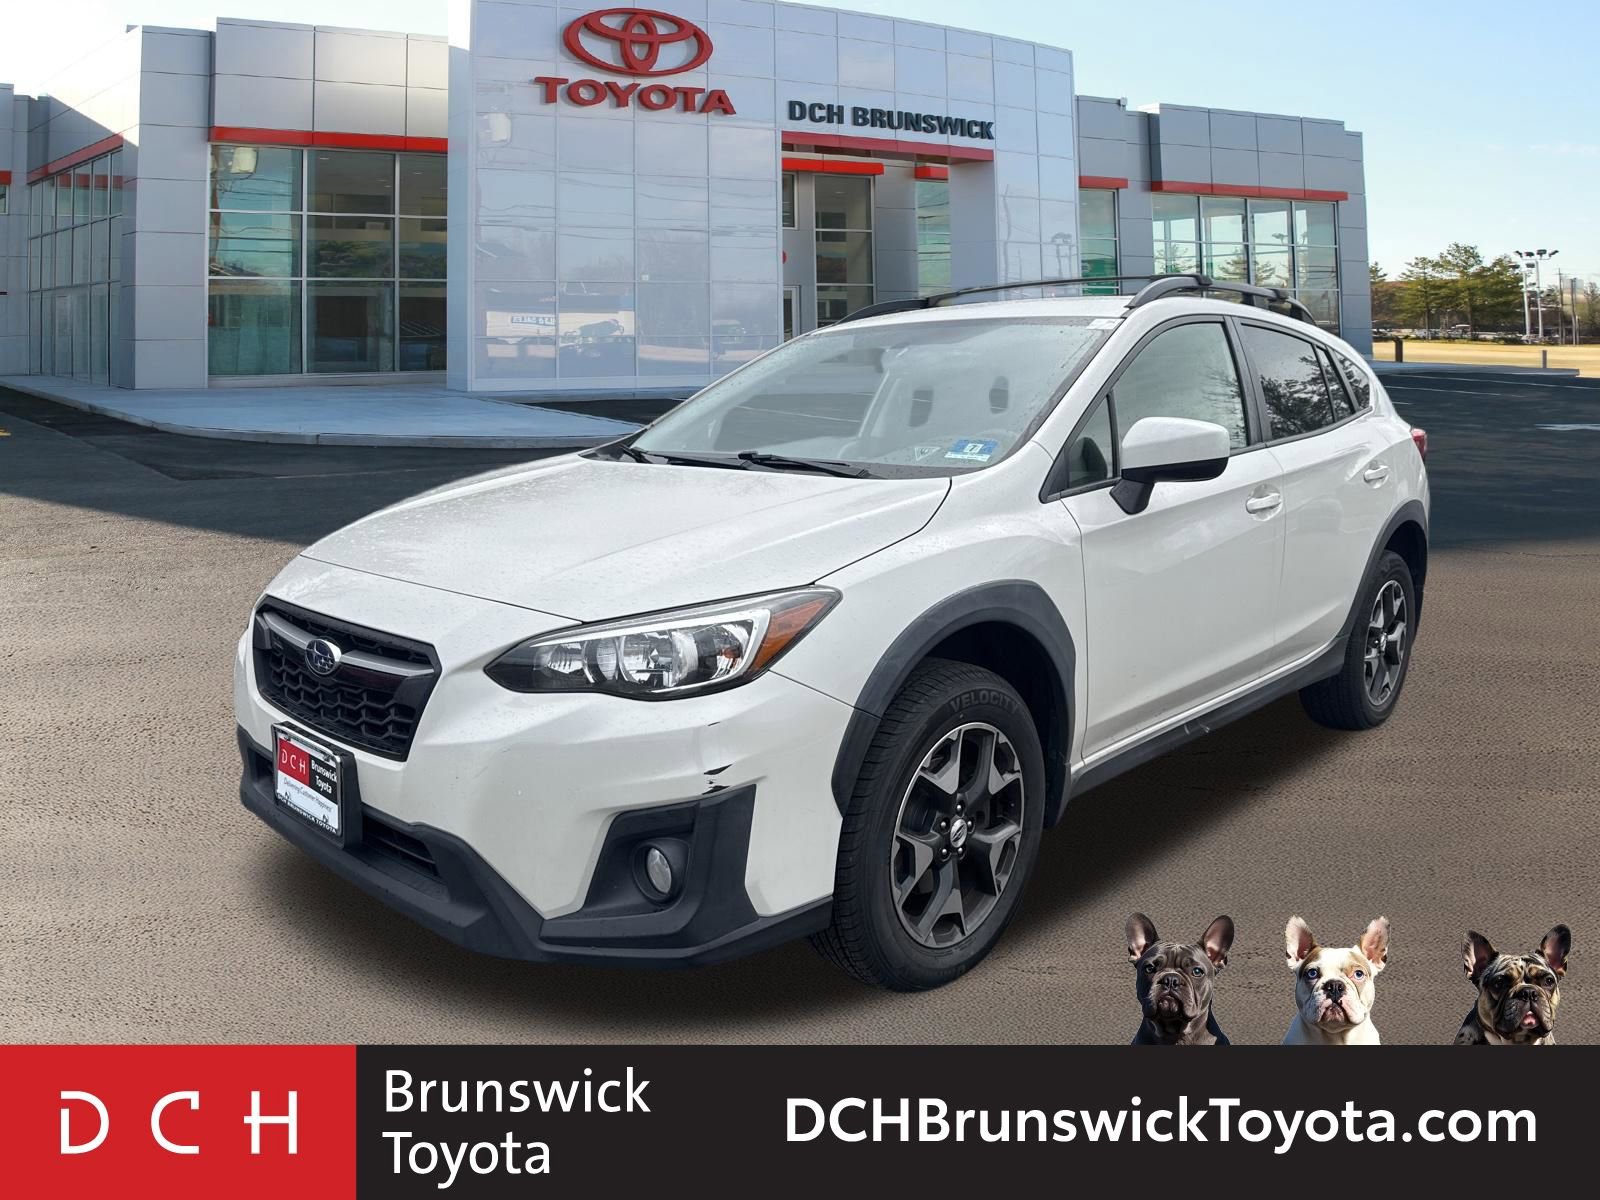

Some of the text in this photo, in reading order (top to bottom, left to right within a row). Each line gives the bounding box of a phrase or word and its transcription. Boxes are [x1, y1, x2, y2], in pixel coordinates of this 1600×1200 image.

[535, 77, 737, 114] TOYOTA
[788, 100, 995, 140] DCH BRUNSWICK
[951, 690, 1018, 713] VELOCITY
[281, 749, 306, 775] DCH
[311, 760, 337, 783] Brunswick
[316, 775, 332, 794] Toyota
[317, 820, 337, 834] TOYOTA
